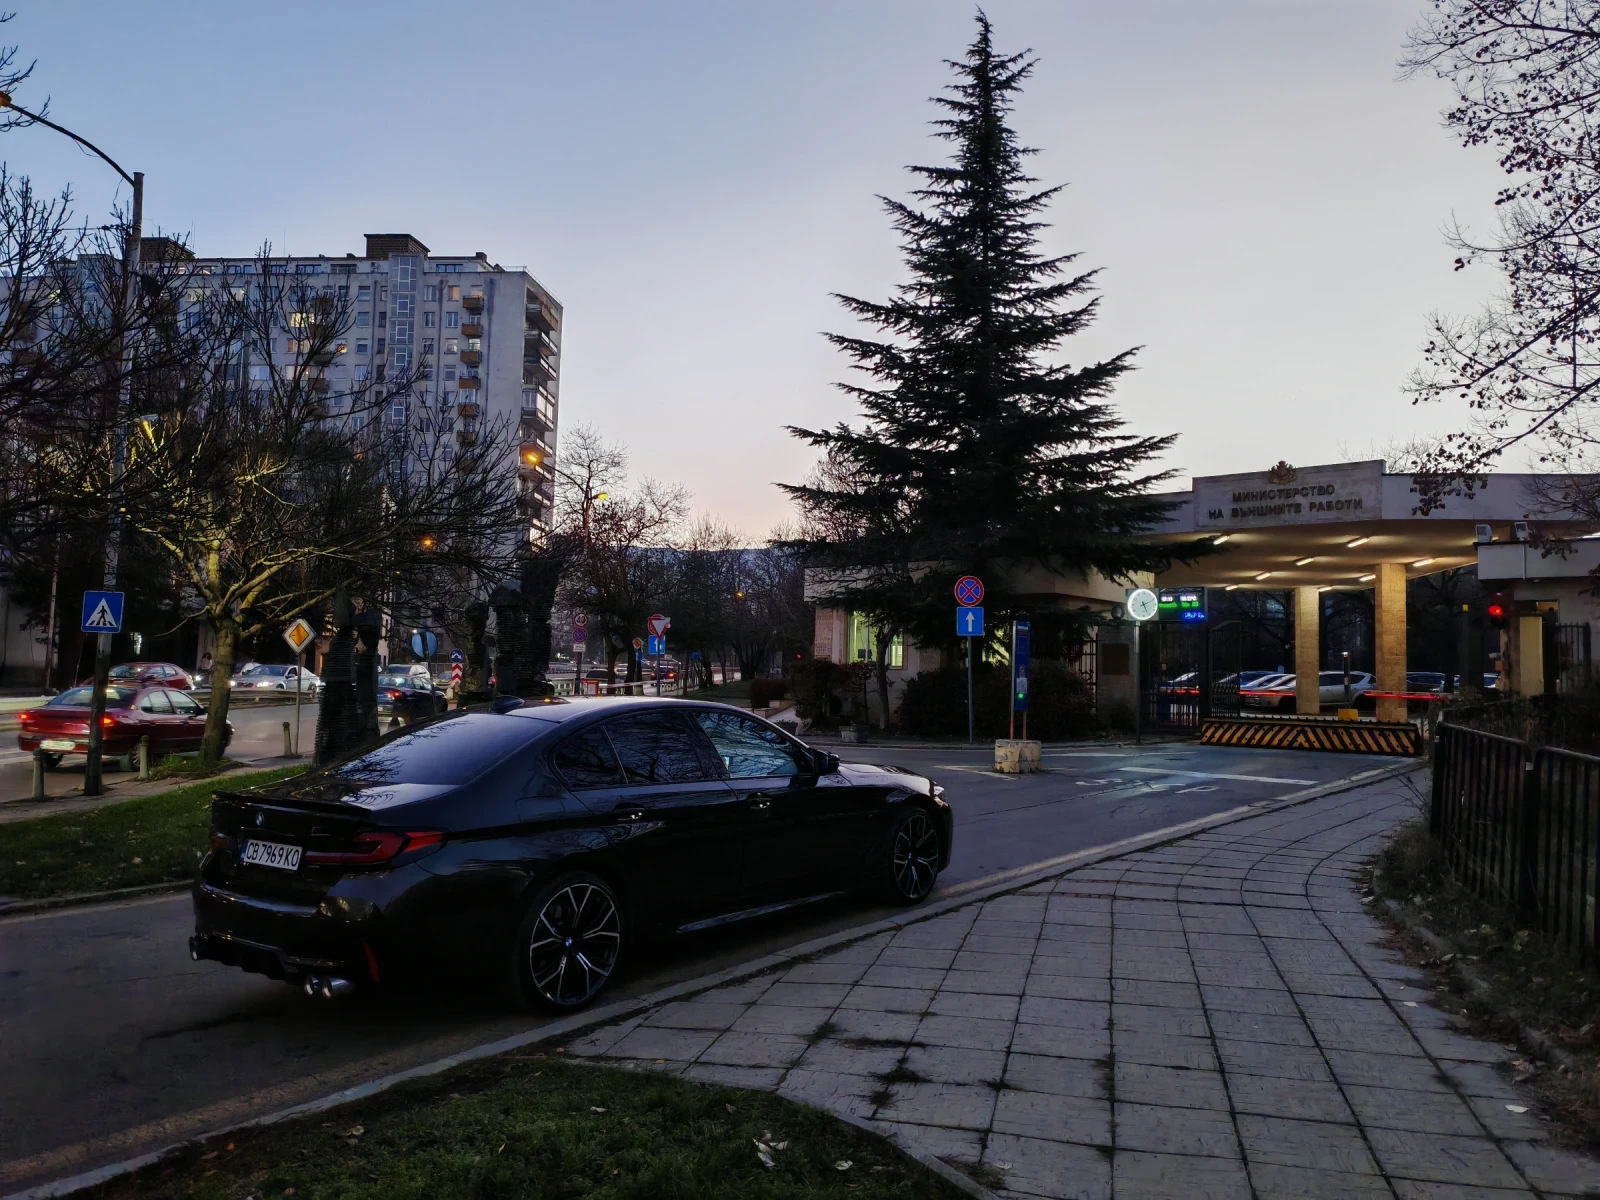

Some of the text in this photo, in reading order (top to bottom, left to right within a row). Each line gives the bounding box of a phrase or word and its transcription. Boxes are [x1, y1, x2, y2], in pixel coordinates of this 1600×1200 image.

[1232, 484, 1335, 502] МИНИСТЕРСТВО
[1208, 498, 1362, 519] НА ВЪНШНИТЕ РАБОТИ
